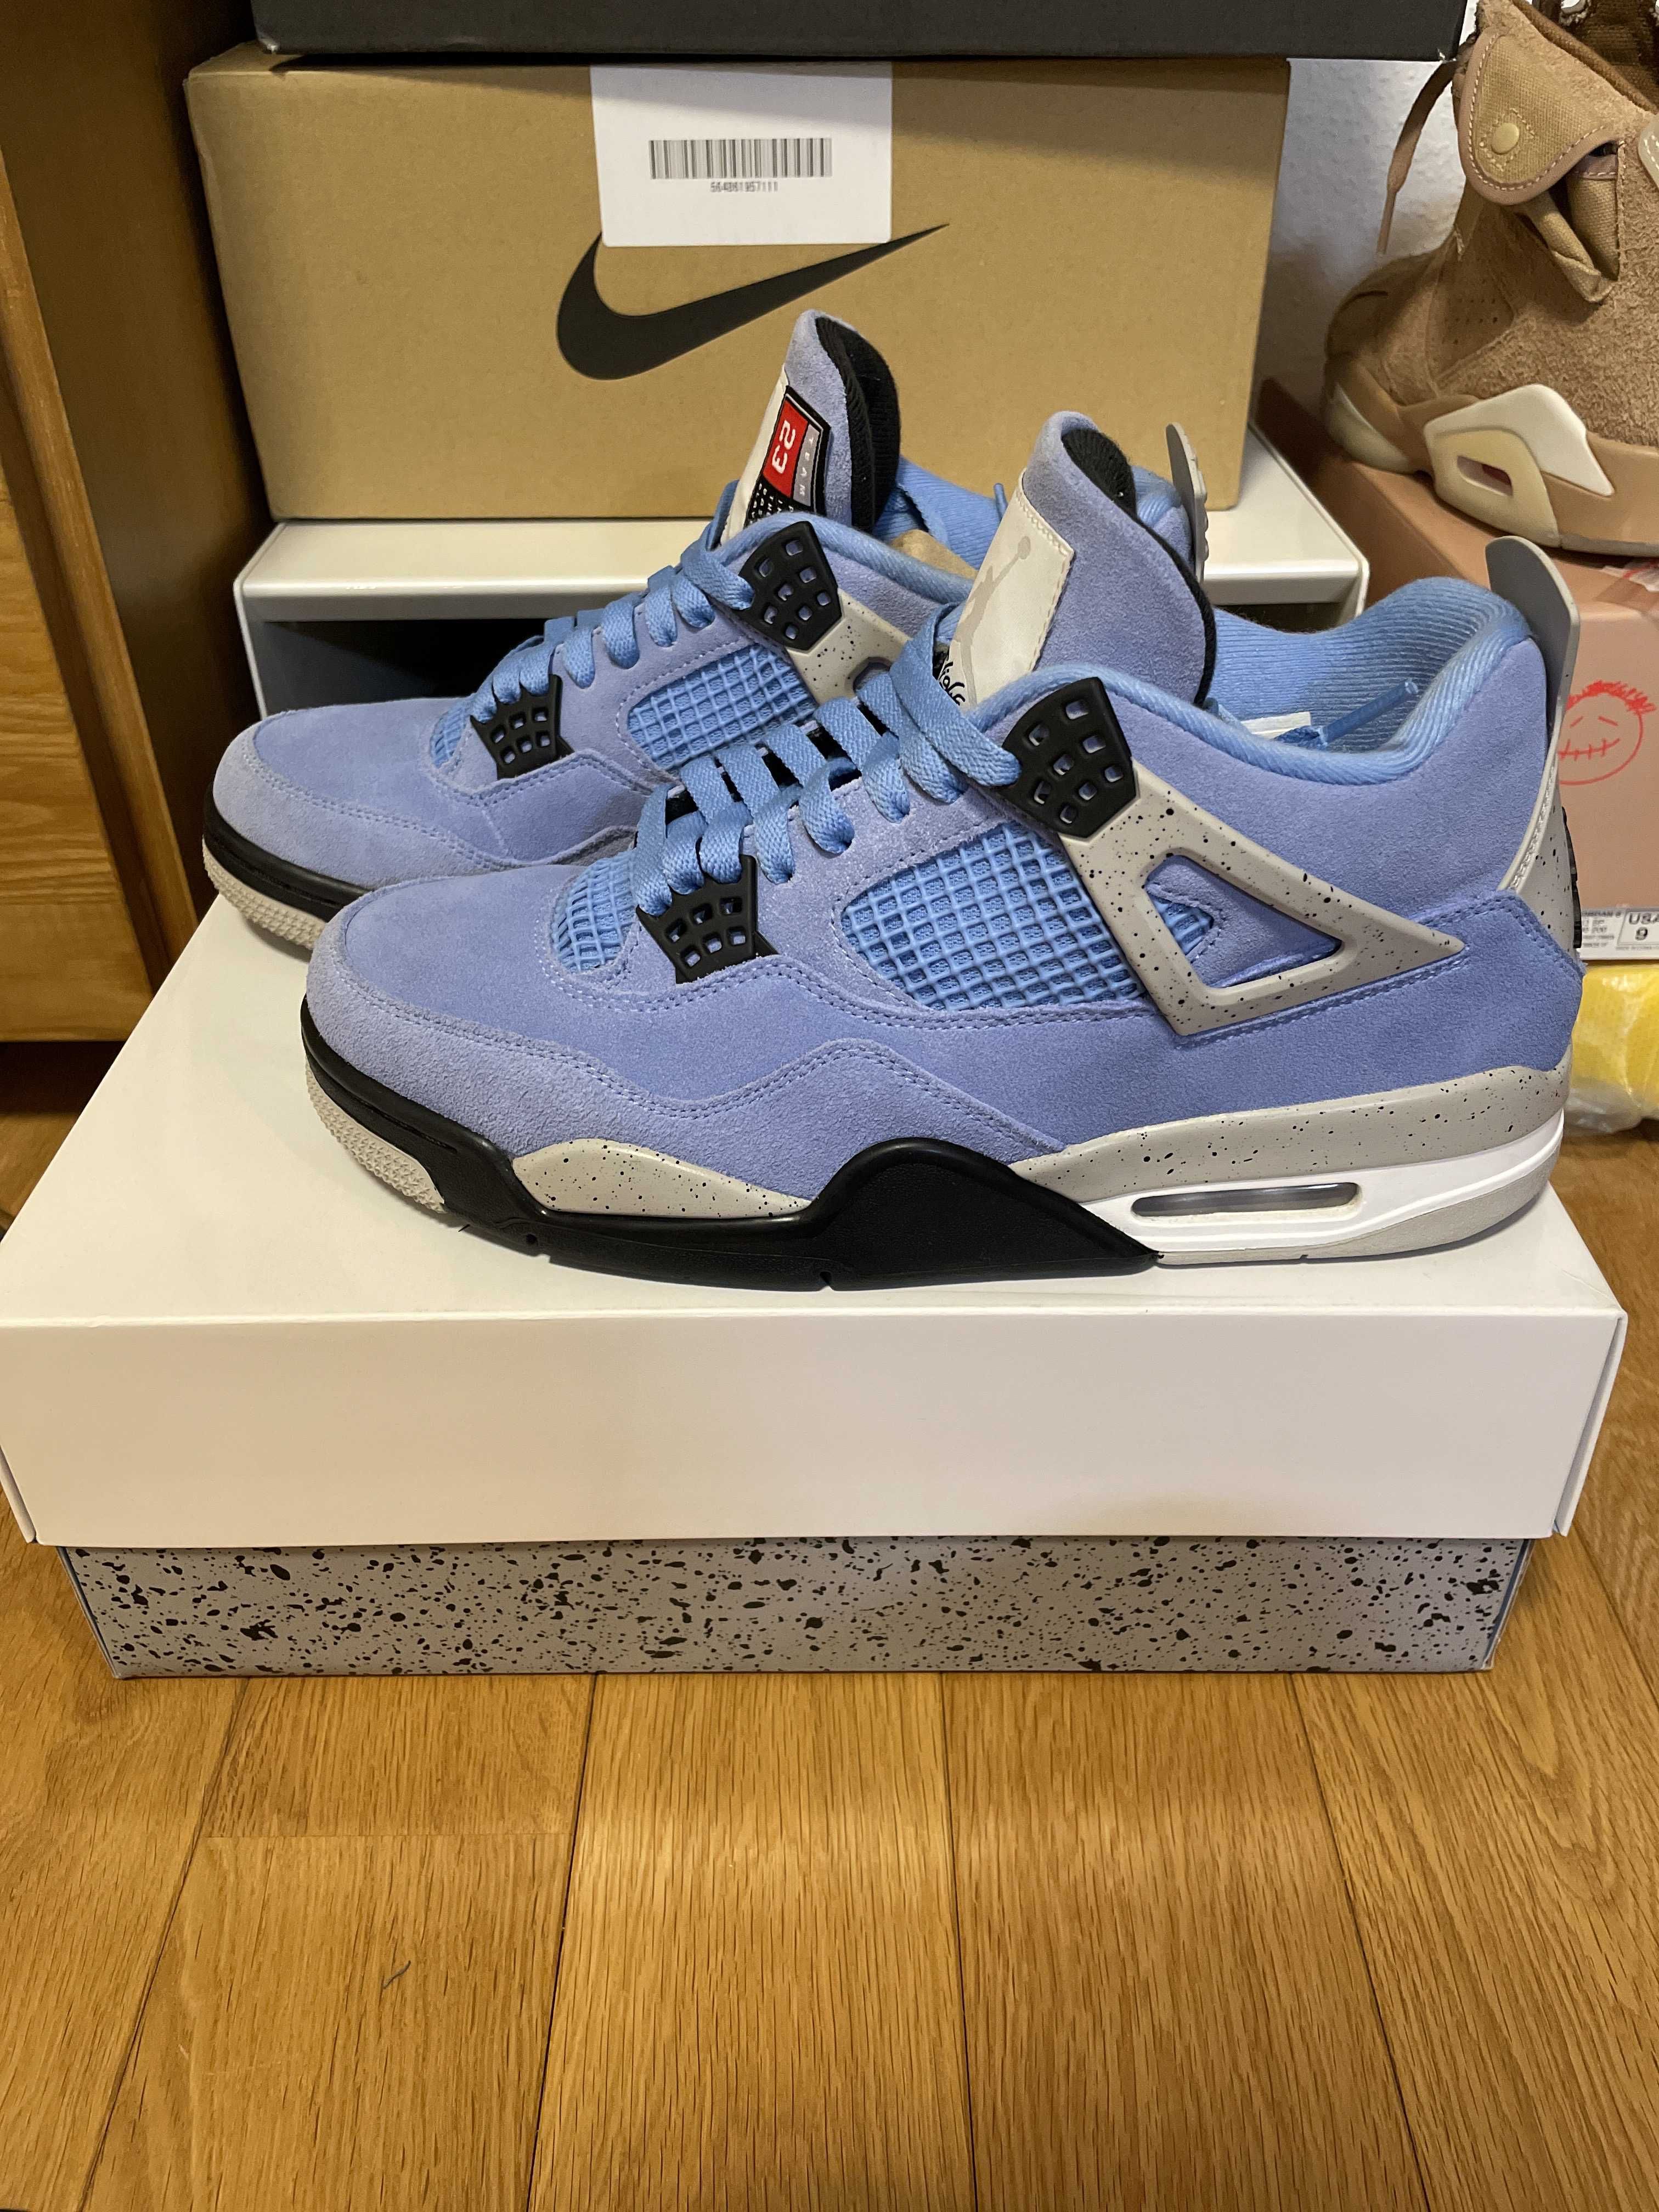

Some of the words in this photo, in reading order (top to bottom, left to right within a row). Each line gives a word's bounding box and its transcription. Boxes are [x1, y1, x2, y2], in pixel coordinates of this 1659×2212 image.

[772, 420, 796, 474] 23
[799, 436, 814, 497] TEAM
[1635, 927, 1649, 940] 9
